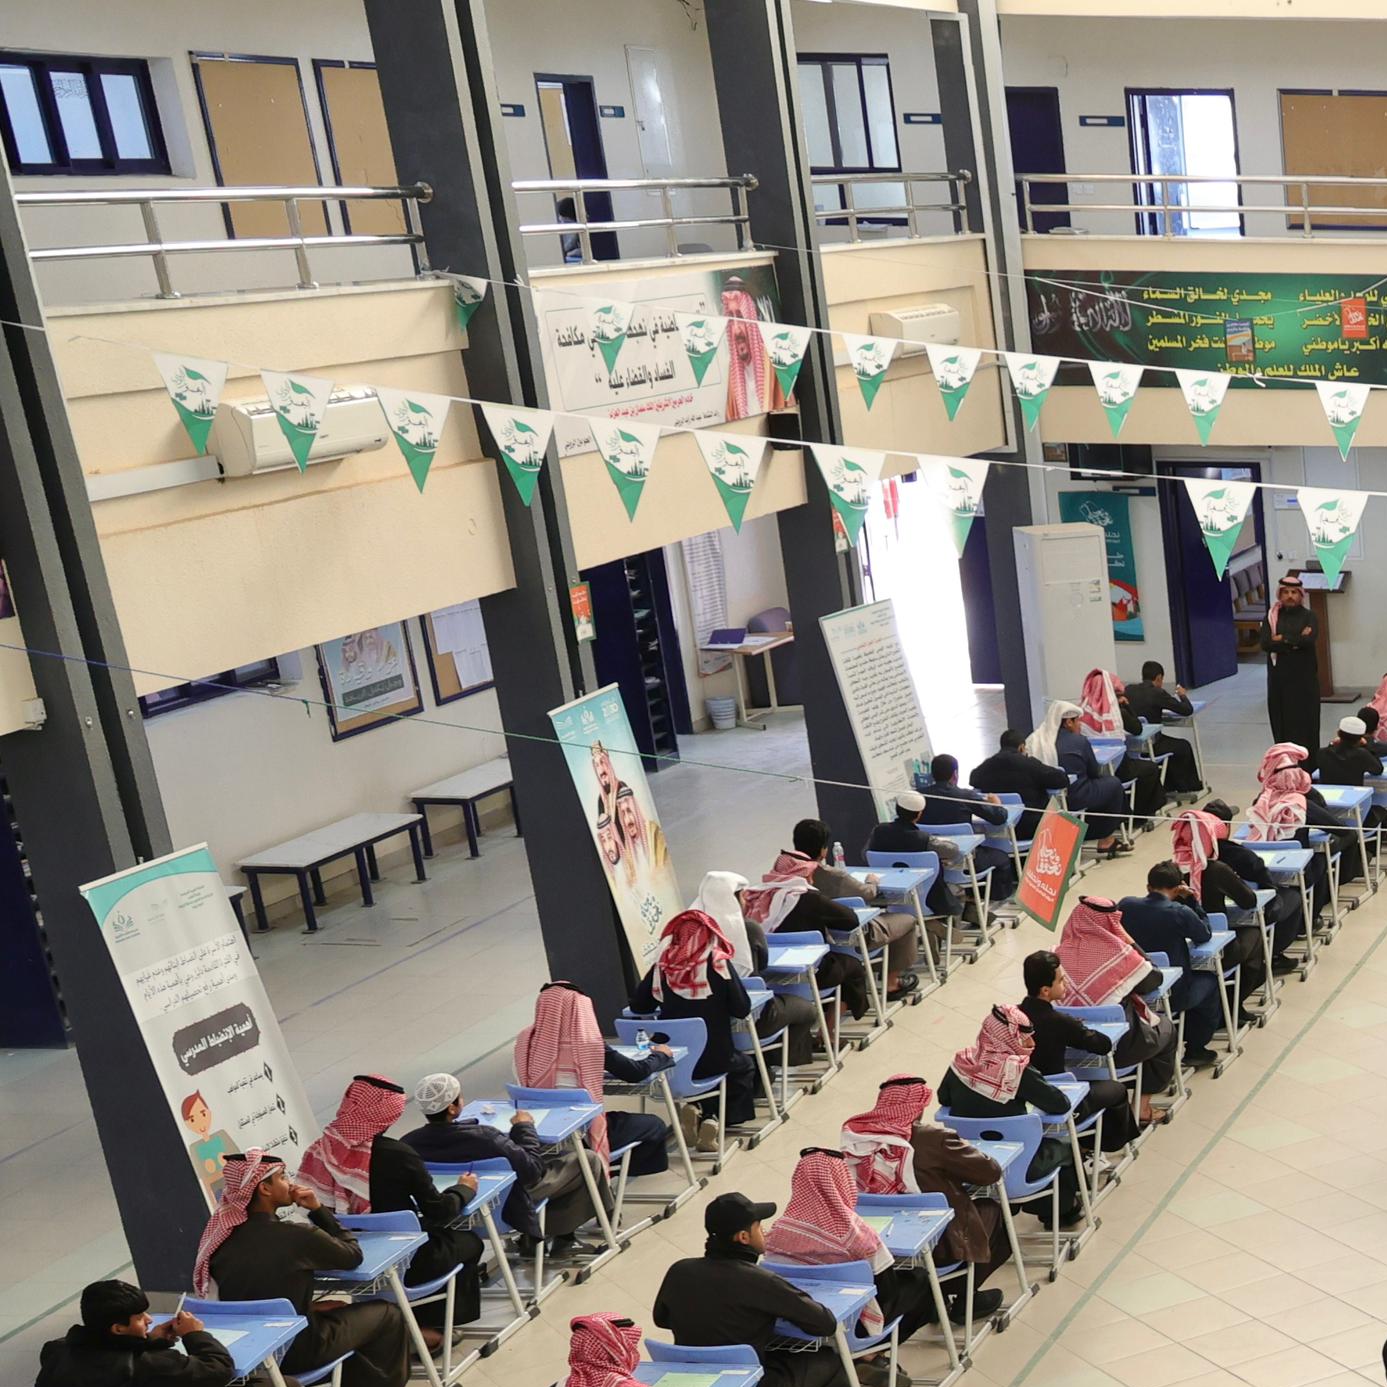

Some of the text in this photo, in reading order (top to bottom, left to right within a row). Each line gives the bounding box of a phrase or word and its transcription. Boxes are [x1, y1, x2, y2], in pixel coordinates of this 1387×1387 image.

[1148, 332, 1186, 351] المسلمين
[1188, 334, 1210, 351] فخر
[1352, 336, 1380, 354] أكبر
[626, 364, 653, 390] والقضاء
[653, 360, 676, 383] الفساد
[1297, 363, 1325, 377] الملك
[1328, 363, 1359, 380] عاش
[232, 1014, 255, 1038] أهمية
[178, 1037, 211, 1067] المدرسي
